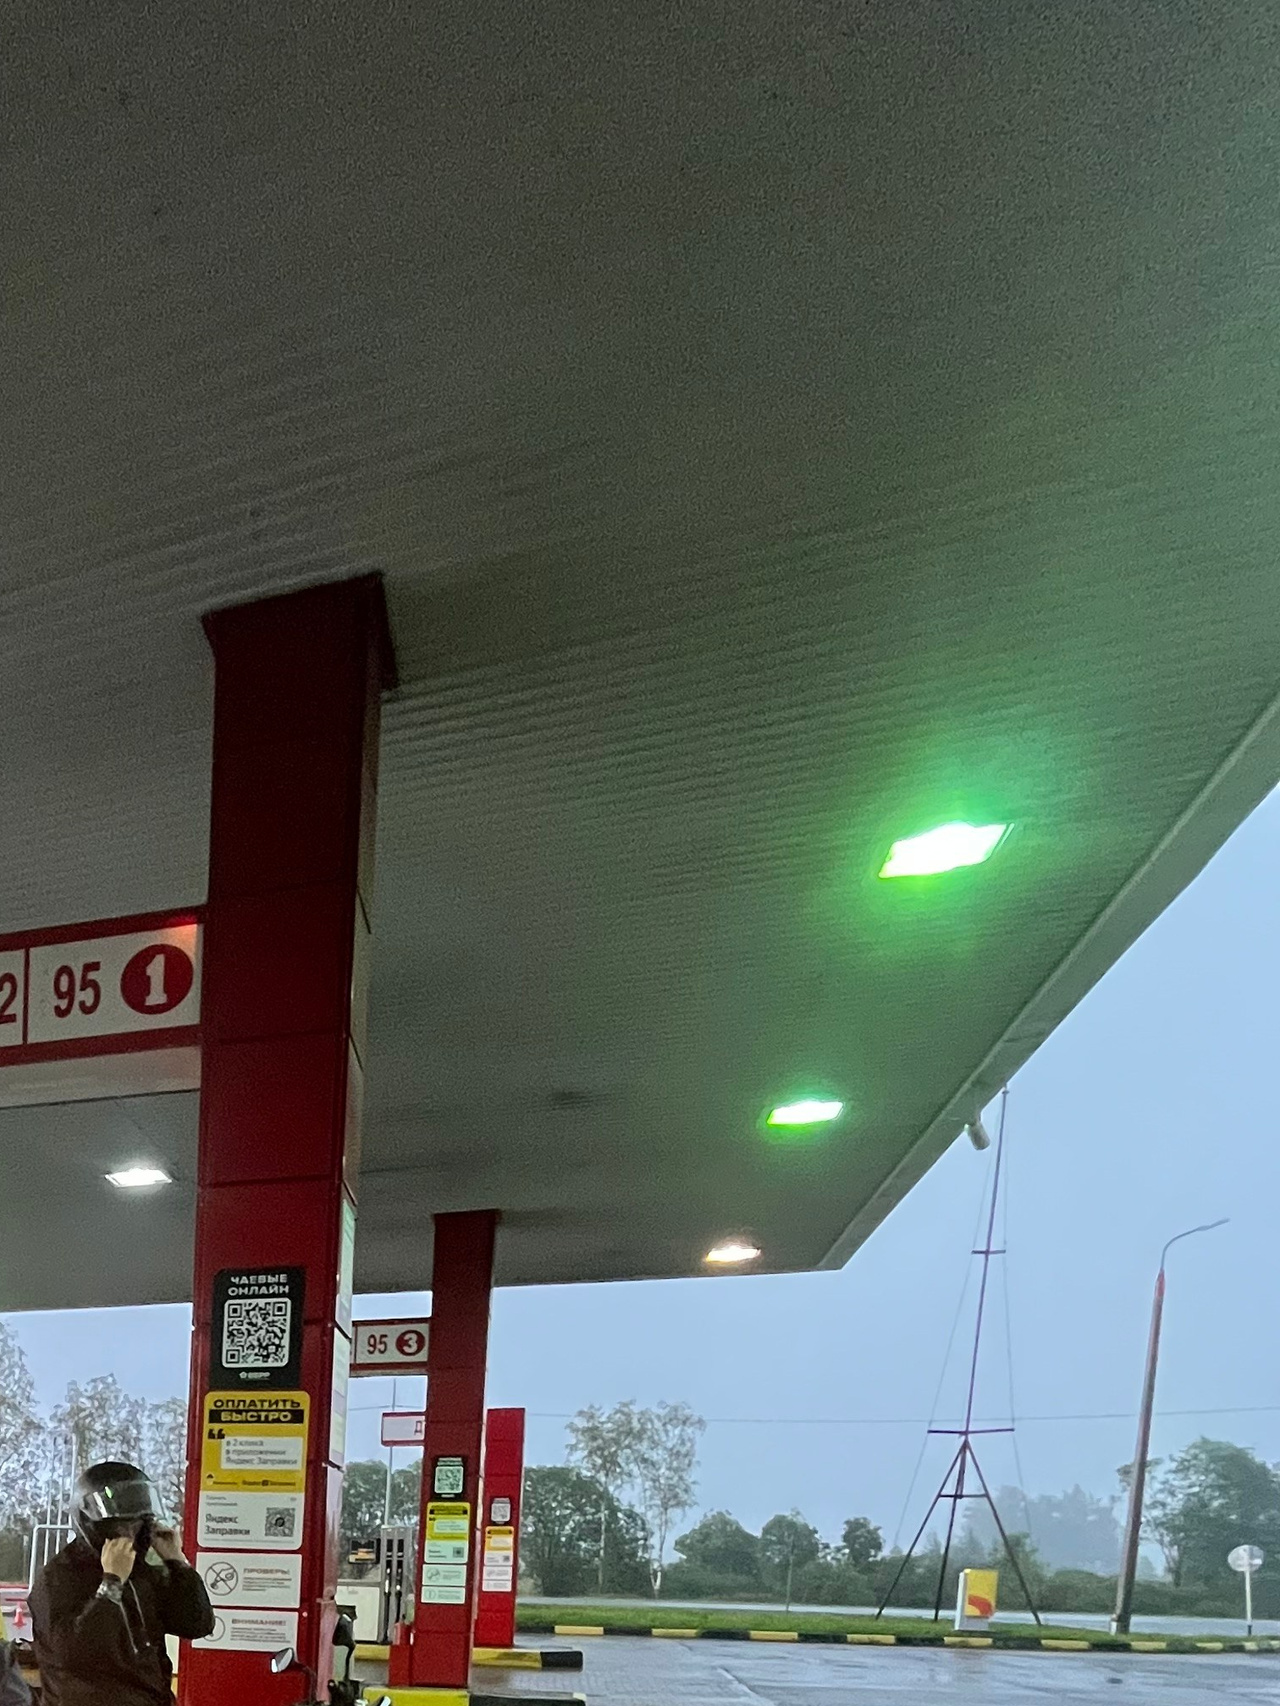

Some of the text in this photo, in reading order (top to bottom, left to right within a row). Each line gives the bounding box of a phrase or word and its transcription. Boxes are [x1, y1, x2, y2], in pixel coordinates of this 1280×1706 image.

[53, 961, 102, 1018] 95
[144, 953, 169, 1007] 1
[230, 1274, 288, 1285] ЧАЕВЫЕ
[227, 1285, 290, 1297] ОНЛАЙН
[367, 1332, 418, 1355] 95 3
[213, 1399, 301, 1409] ОПЛАТИТЬ
[220, 1411, 292, 1422] БЫСТРО
[205, 1513, 238, 1524] Яндекс
[204, 1525, 251, 1536] Заправки
